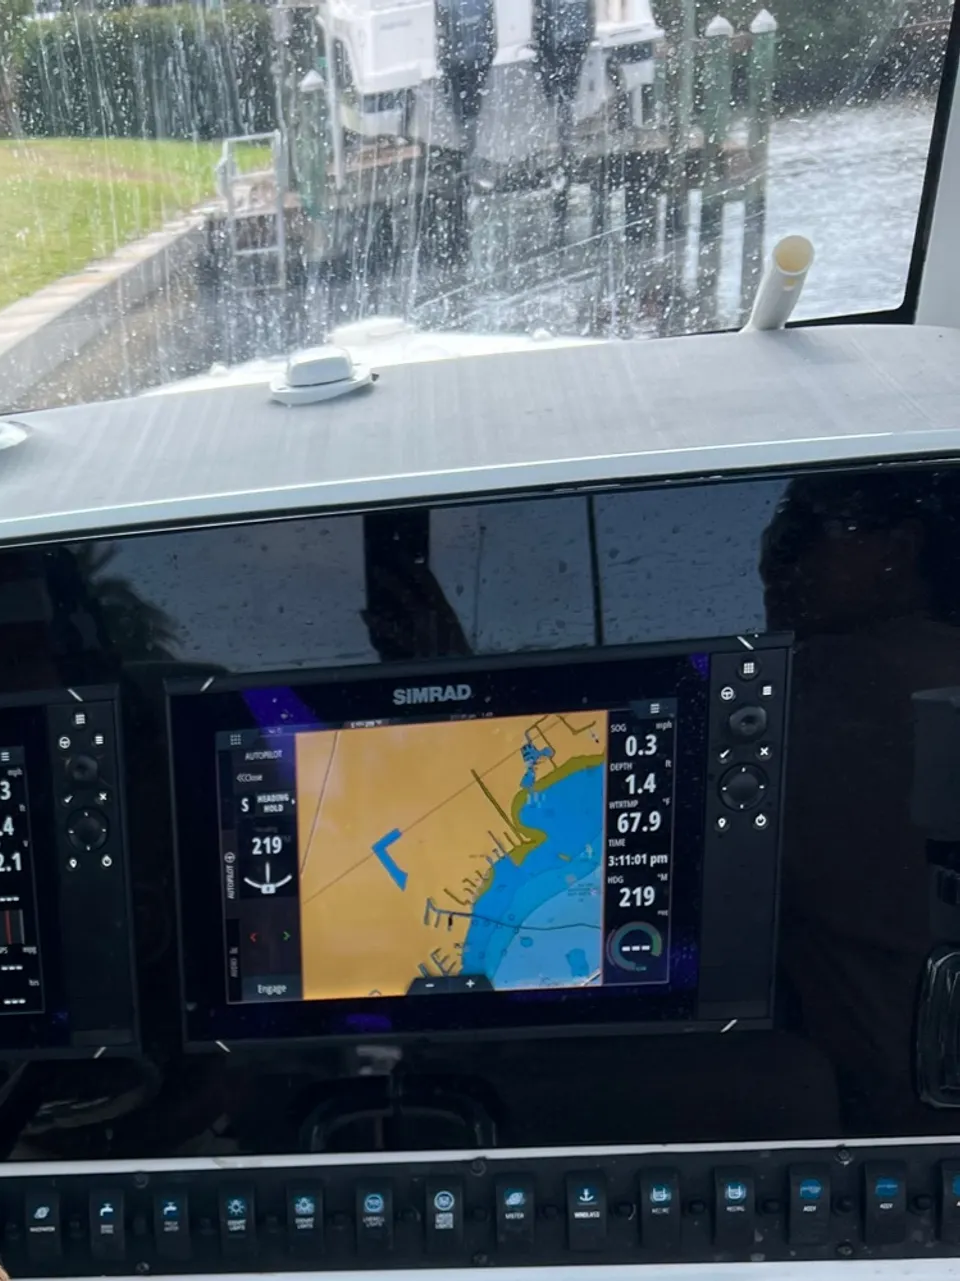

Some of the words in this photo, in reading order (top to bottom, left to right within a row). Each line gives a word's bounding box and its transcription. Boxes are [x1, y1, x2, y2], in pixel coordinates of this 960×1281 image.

[392, 684, 472, 706] SIMRAD
[610, 724, 627, 733] SOG
[656, 721, 672, 731] mph
[625, 734, 657, 757] 0.3
[245, 750, 283, 760] AUTOPILOT
[610, 762, 633, 772] DEPTH
[625, 772, 656, 795] 1.4
[257, 793, 289, 803] HEADING
[241, 798, 250, 812] S
[263, 804, 283, 813] HOLD
[617, 810, 661, 834] 67.9
[252, 835, 282, 855] 219
[608, 838, 626, 847] TIME
[608, 853, 647, 867] 3:11:01
[650, 854, 668, 867] pm
[608, 876, 624, 884] HDG
[619, 886, 655, 908] 219
[257, 983, 287, 996] Engage
